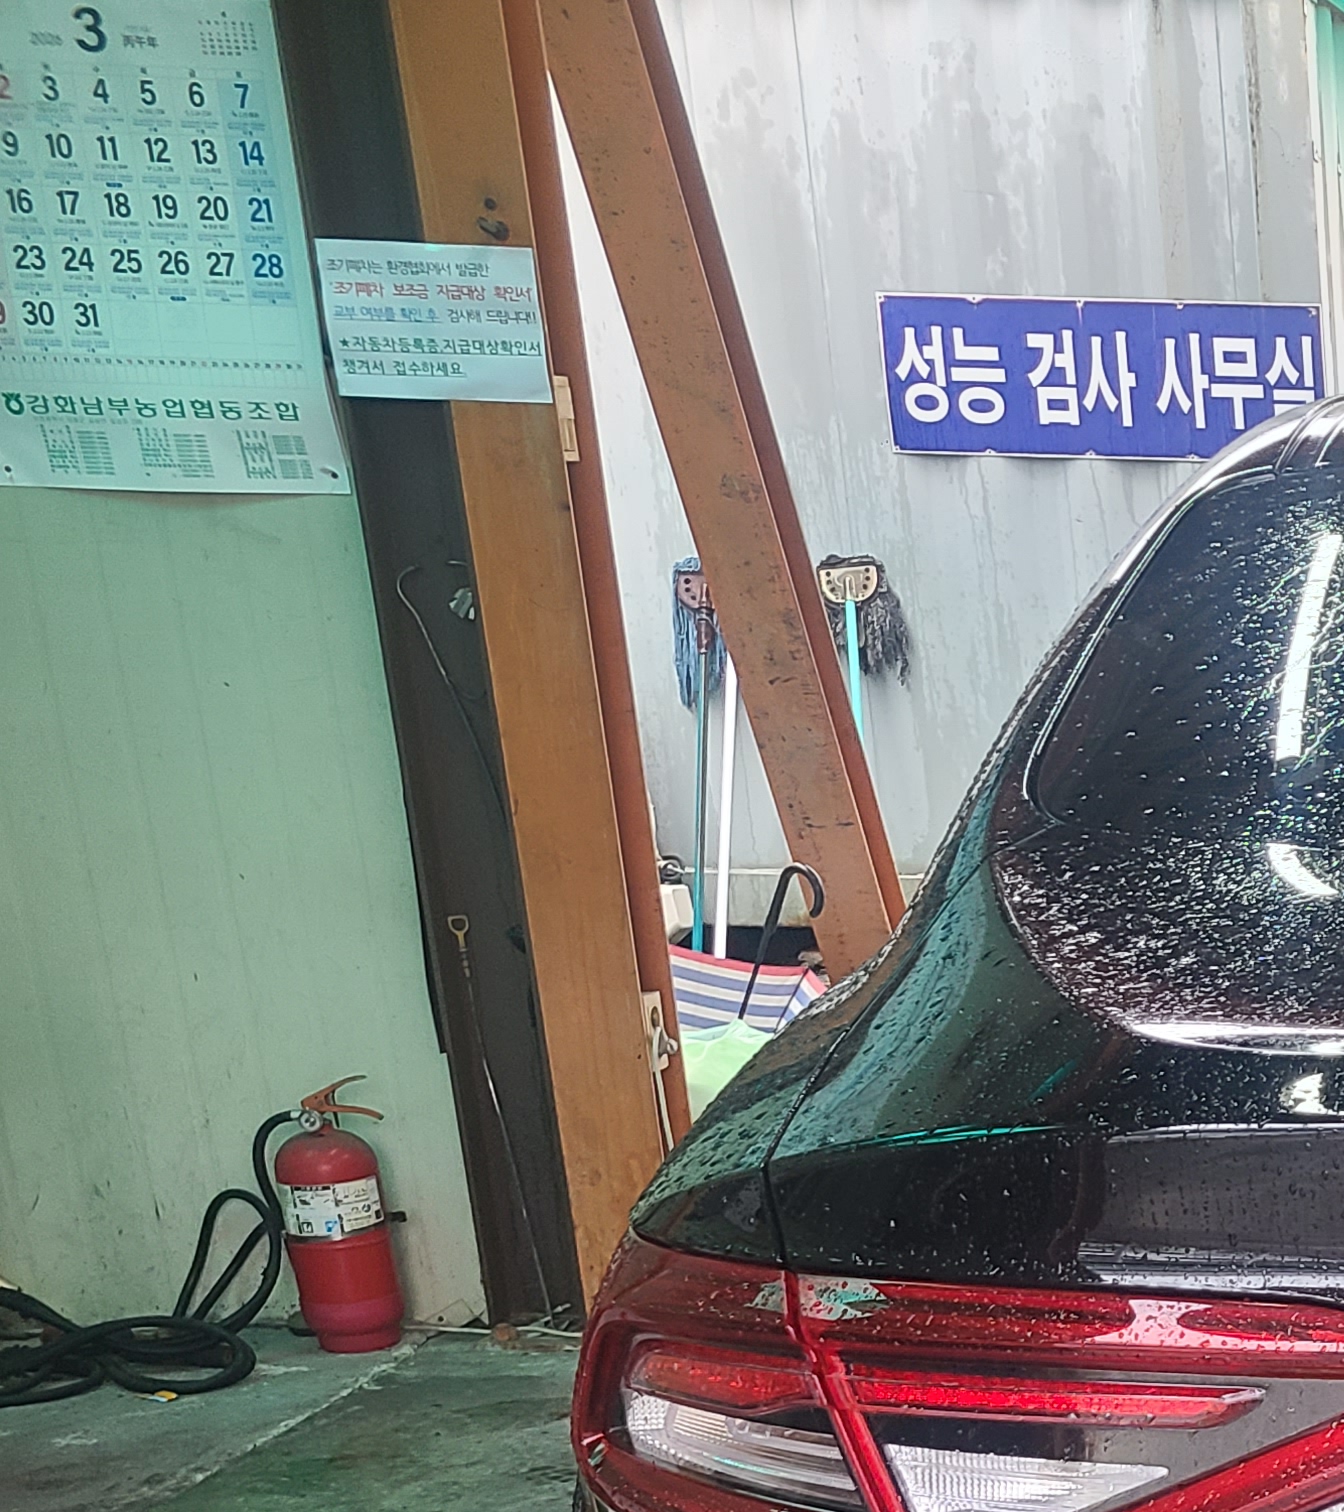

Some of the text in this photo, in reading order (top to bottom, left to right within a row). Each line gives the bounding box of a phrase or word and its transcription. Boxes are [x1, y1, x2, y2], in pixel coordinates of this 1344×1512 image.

[73, 6, 107, 52] 3
[42, 75, 60, 102] 3
[92, 78, 110, 104] 4
[140, 80, 157, 106] 5
[188, 81, 205, 108] 6
[234, 83, 250, 109] 7
[2, 131, 265, 166] 9 10 11 12 13 14
[5, 188, 274, 223] 16 17 18 19 20 21
[12, 244, 284, 279] 23 24 25 26 27 28
[455, 262, 491, 278] 발급한
[436, 284, 486, 301] 지급대상
[22, 300, 100, 328] 30 31
[447, 309, 482, 324] 검사해
[393, 361, 463, 376] 접수하세요
[895, 324, 1008, 425] 성능
[1025, 328, 1138, 428] 검사
[26, 394, 301, 423] 강화남부농업협동조합
